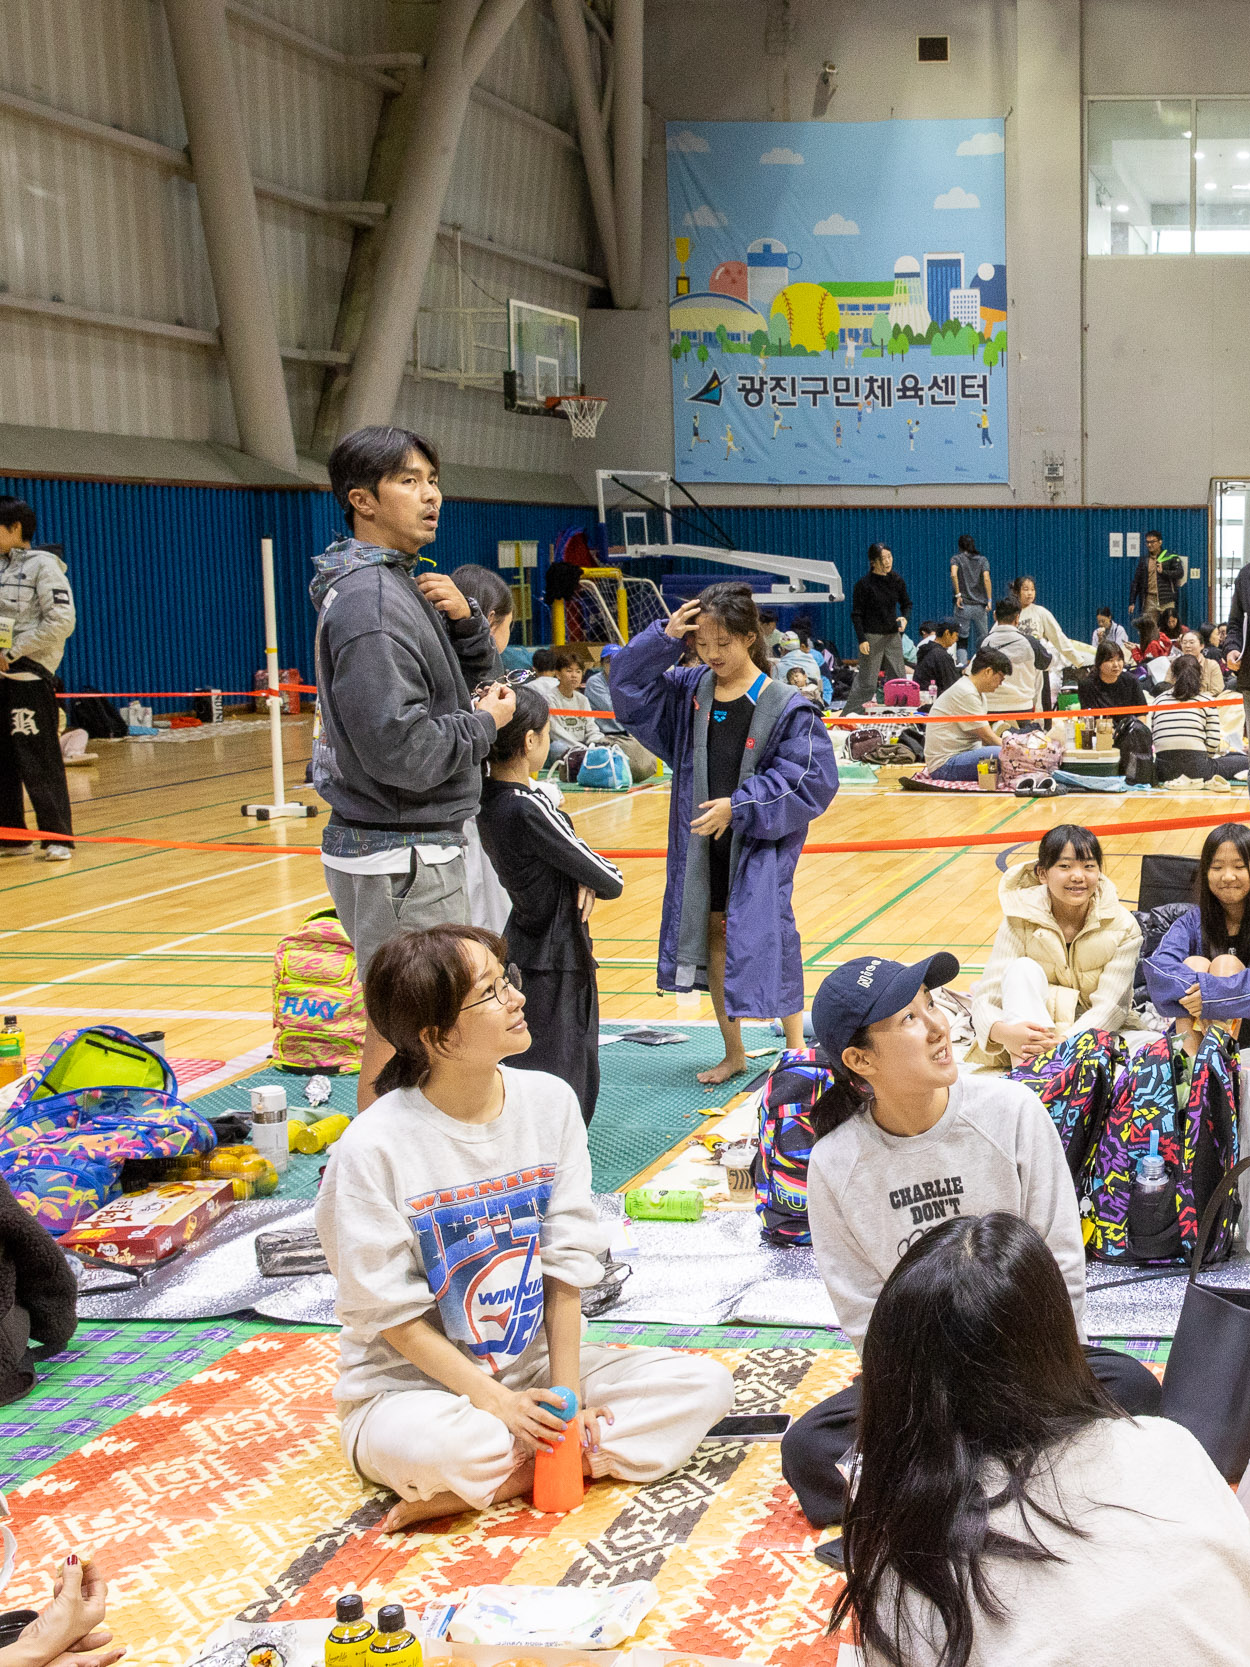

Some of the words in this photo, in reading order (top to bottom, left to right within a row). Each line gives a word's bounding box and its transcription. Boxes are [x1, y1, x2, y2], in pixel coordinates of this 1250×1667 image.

[736, 374, 989, 407] 광진구민체육센터
[281, 996, 342, 1020] FUNKY
[889, 1175, 964, 1210] CHARLIE
[910, 1197, 961, 1225] DON'T
